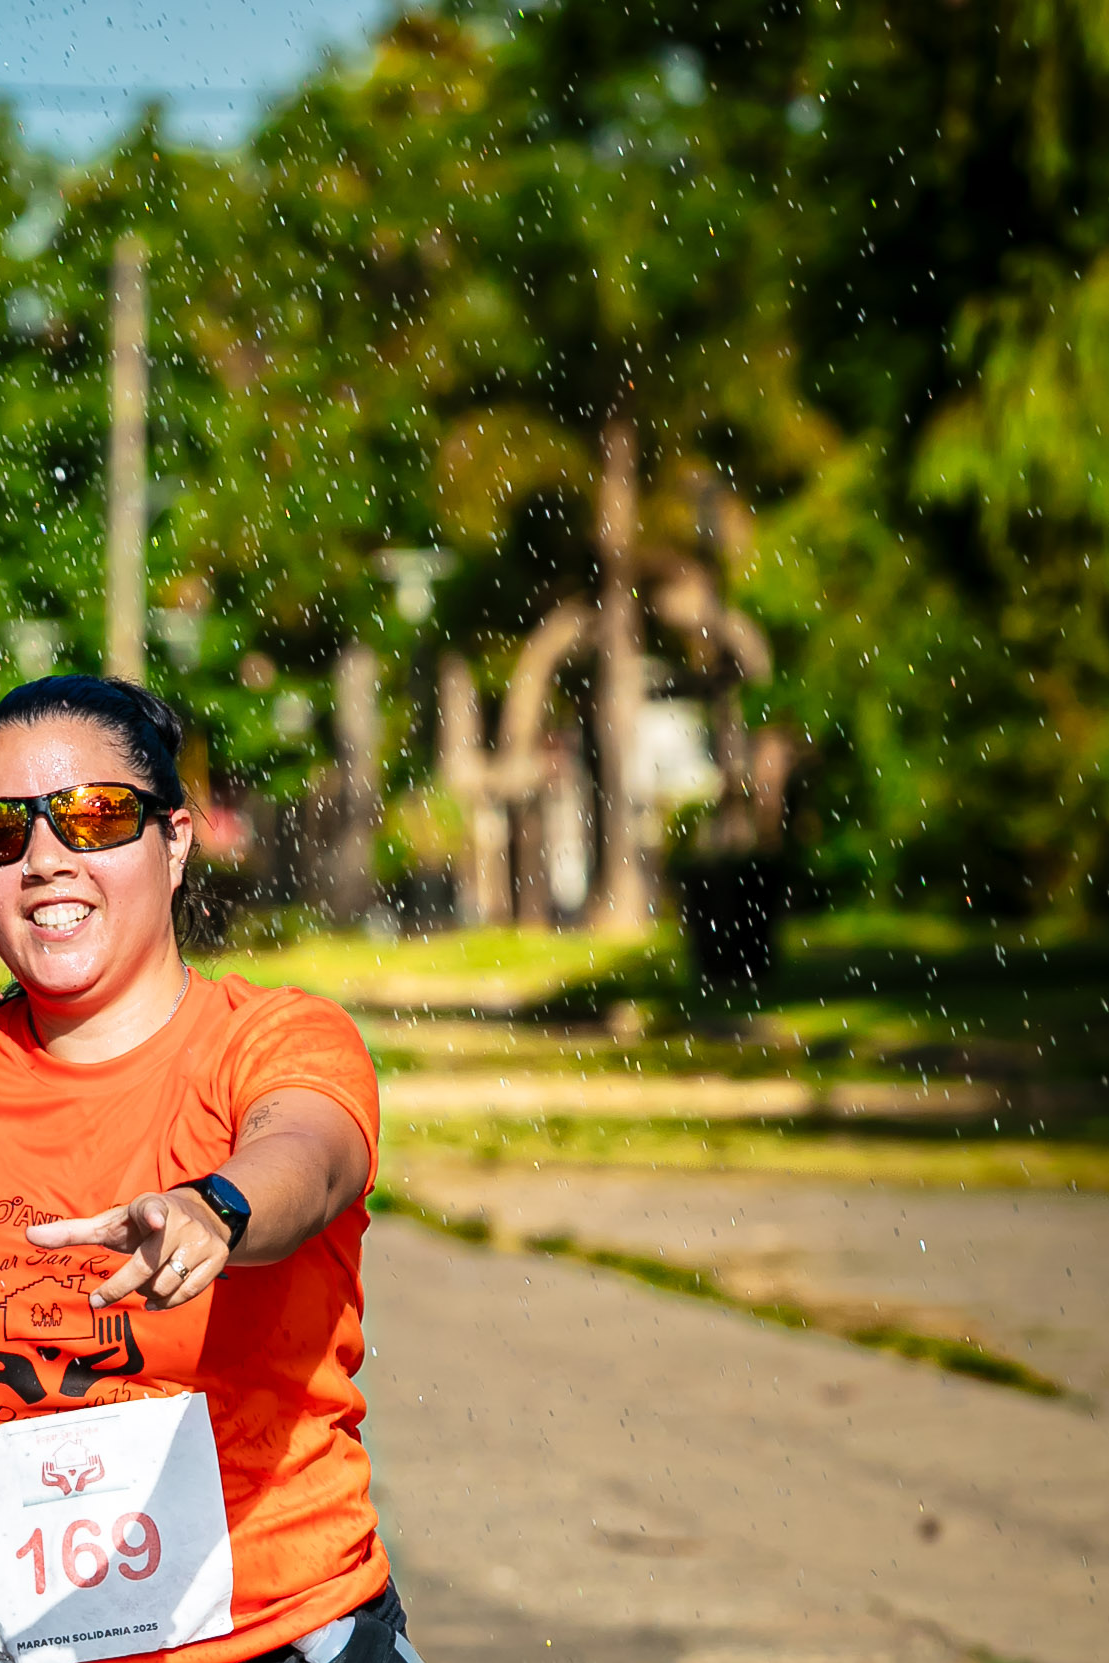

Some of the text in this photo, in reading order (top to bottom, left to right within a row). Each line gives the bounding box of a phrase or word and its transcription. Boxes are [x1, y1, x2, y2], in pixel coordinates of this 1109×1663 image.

[25, 1249, 73, 1267] San
[15, 1511, 162, 1595] 169
[16, 1622, 159, 1652] MARATON SOLIDARIA 2025
